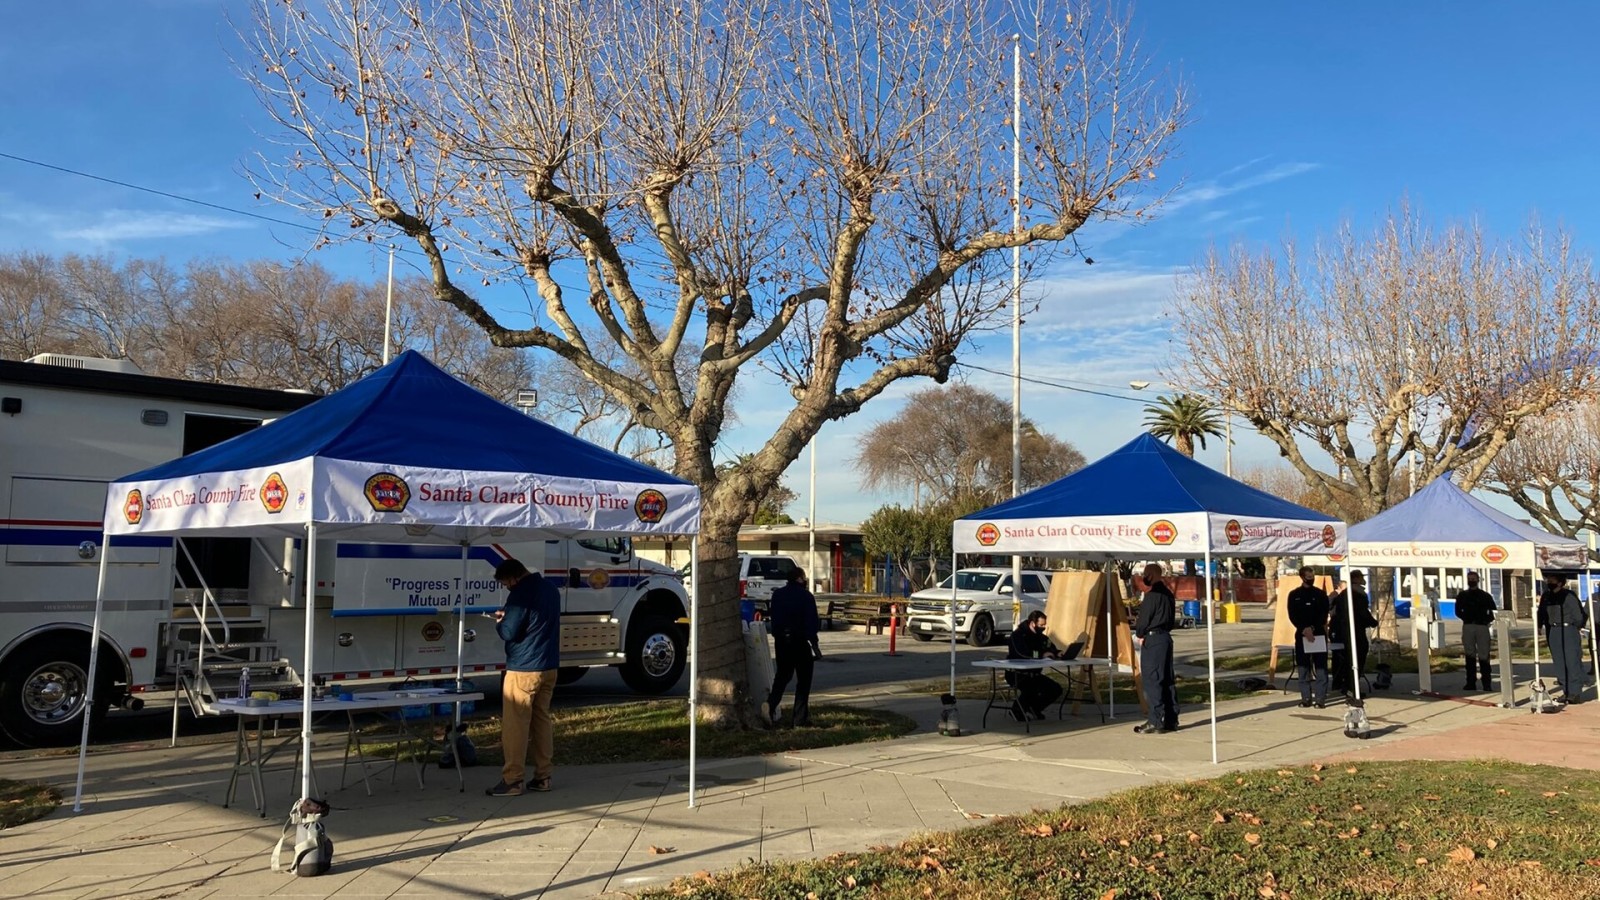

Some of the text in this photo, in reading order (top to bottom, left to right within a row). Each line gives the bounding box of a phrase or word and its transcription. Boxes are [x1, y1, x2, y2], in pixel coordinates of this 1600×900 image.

[146, 484, 256, 511] Santa Clara County Fire
[419, 482, 473, 502] Santa
[479, 485, 526, 504] Clara
[531, 488, 594, 513] County
[597, 492, 629, 510] Fire
[1004, 526, 1035, 538] Santa
[1037, 525, 1068, 537] Clara
[1070, 524, 1114, 540] County
[1117, 524, 1142, 537] Fire
[1244, 525, 1264, 537] Santa
[1265, 525, 1282, 538] Clara
[1284, 526, 1307, 540] County
[1308, 528, 1320, 540] Fire
[1351, 547, 1379, 557] Santa
[1381, 547, 1409, 557] Clara
[1412, 547, 1451, 560] County
[1455, 548, 1477, 557] Fire
[453, 577, 503, 592] Trough
[408, 593, 451, 607] Mutual
